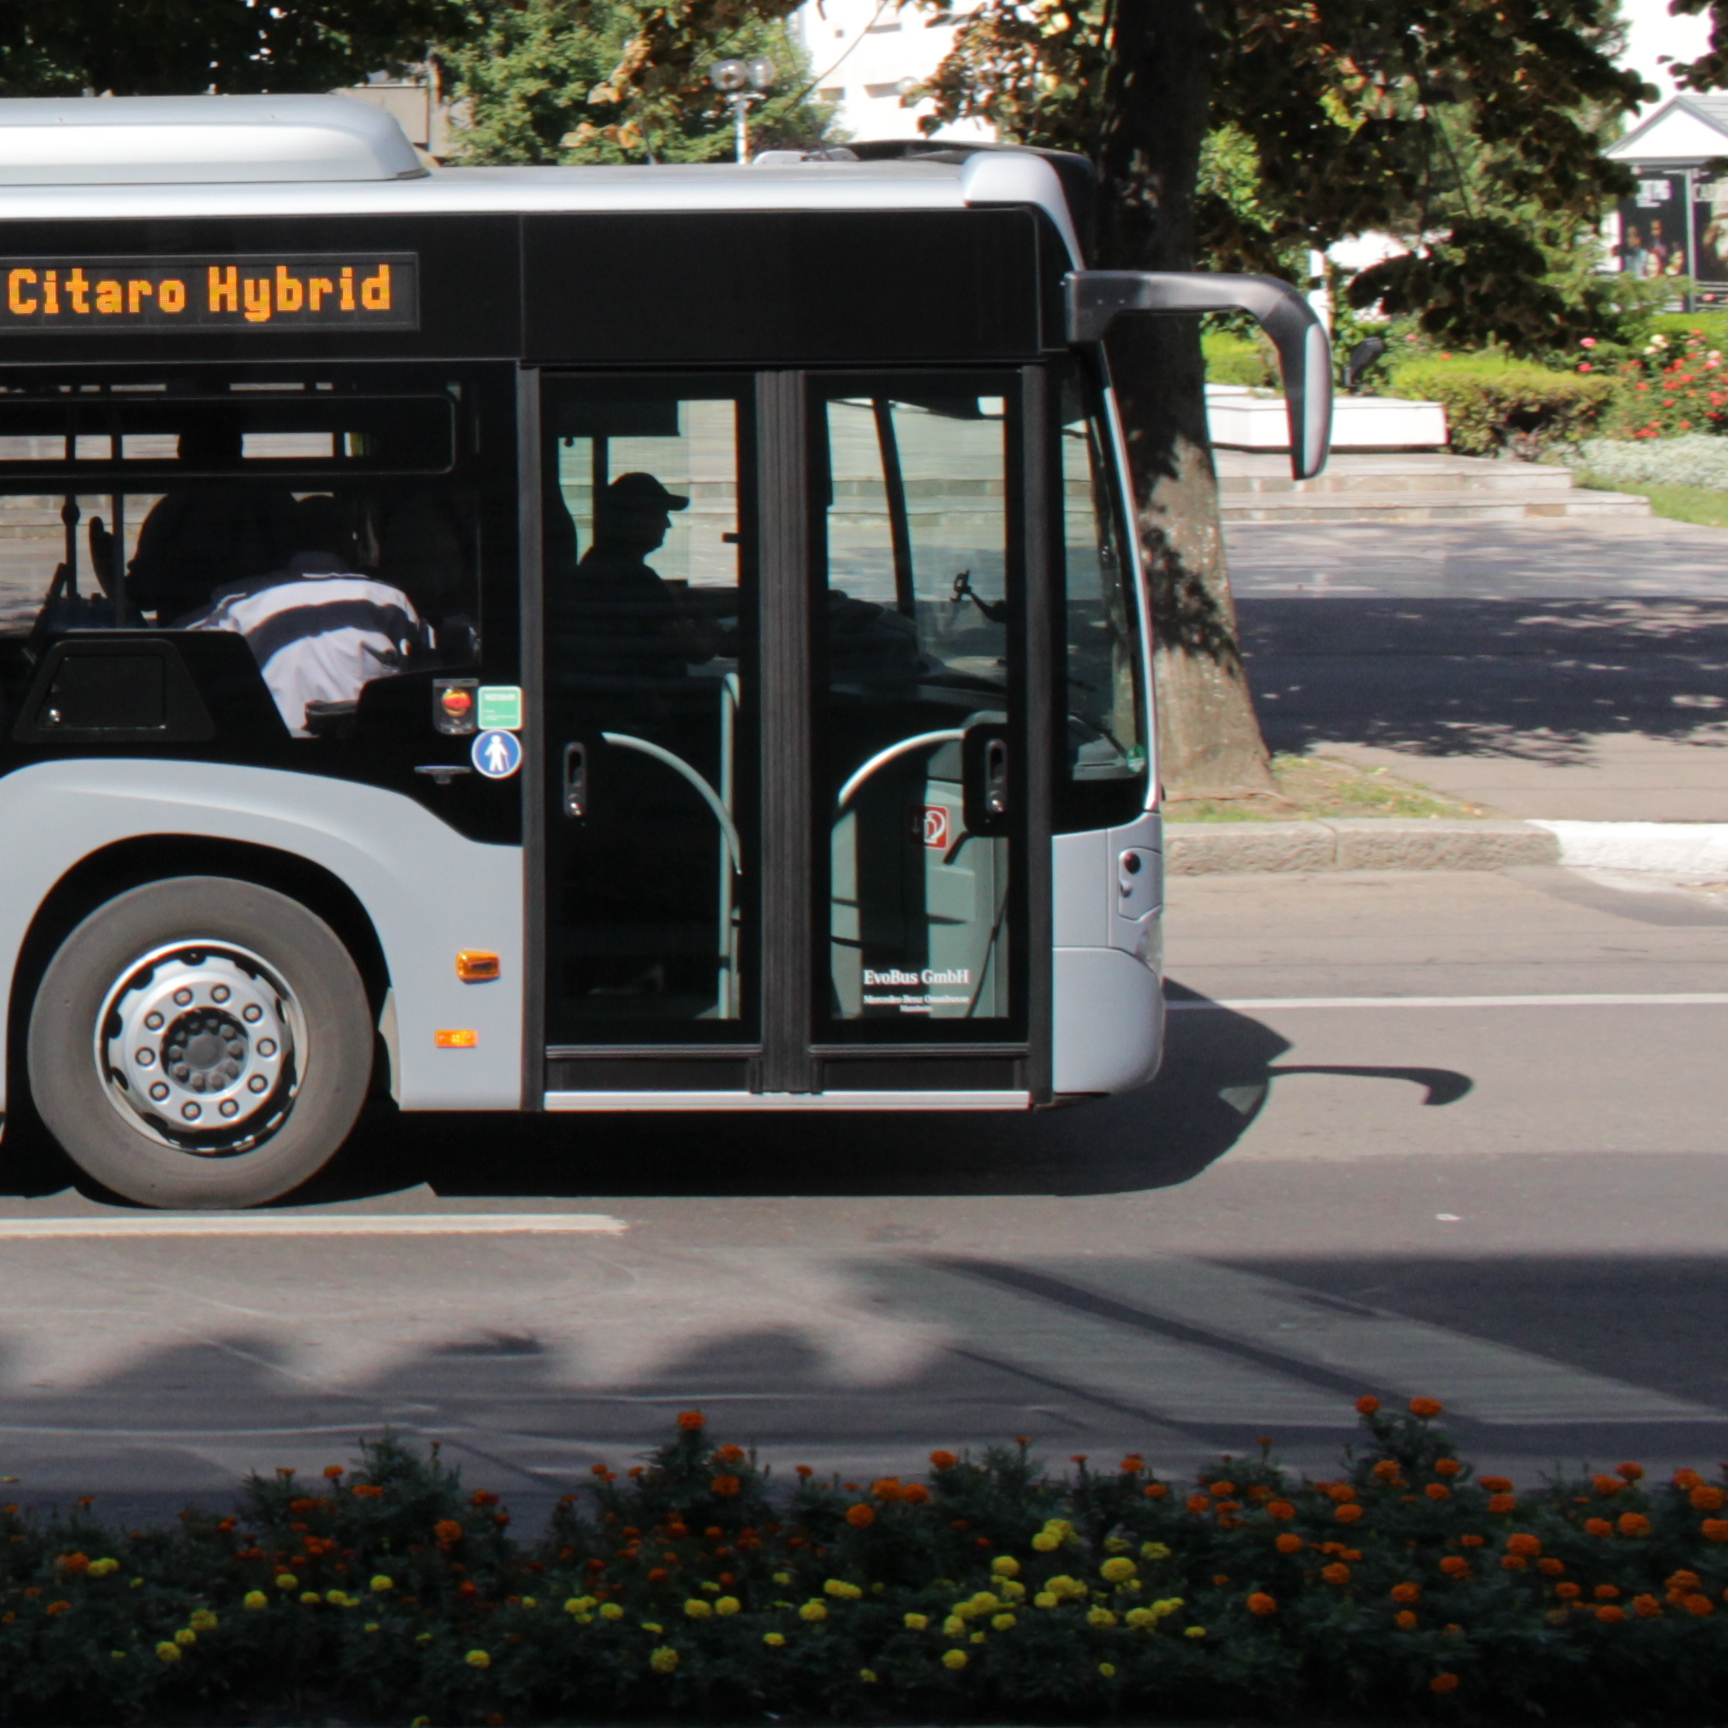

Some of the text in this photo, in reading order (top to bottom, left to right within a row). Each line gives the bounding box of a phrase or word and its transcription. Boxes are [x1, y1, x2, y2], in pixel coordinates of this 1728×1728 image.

[7, 263, 392, 322] Citaro Hybrid
[863, 969, 970, 985] EvoBus GmbH
